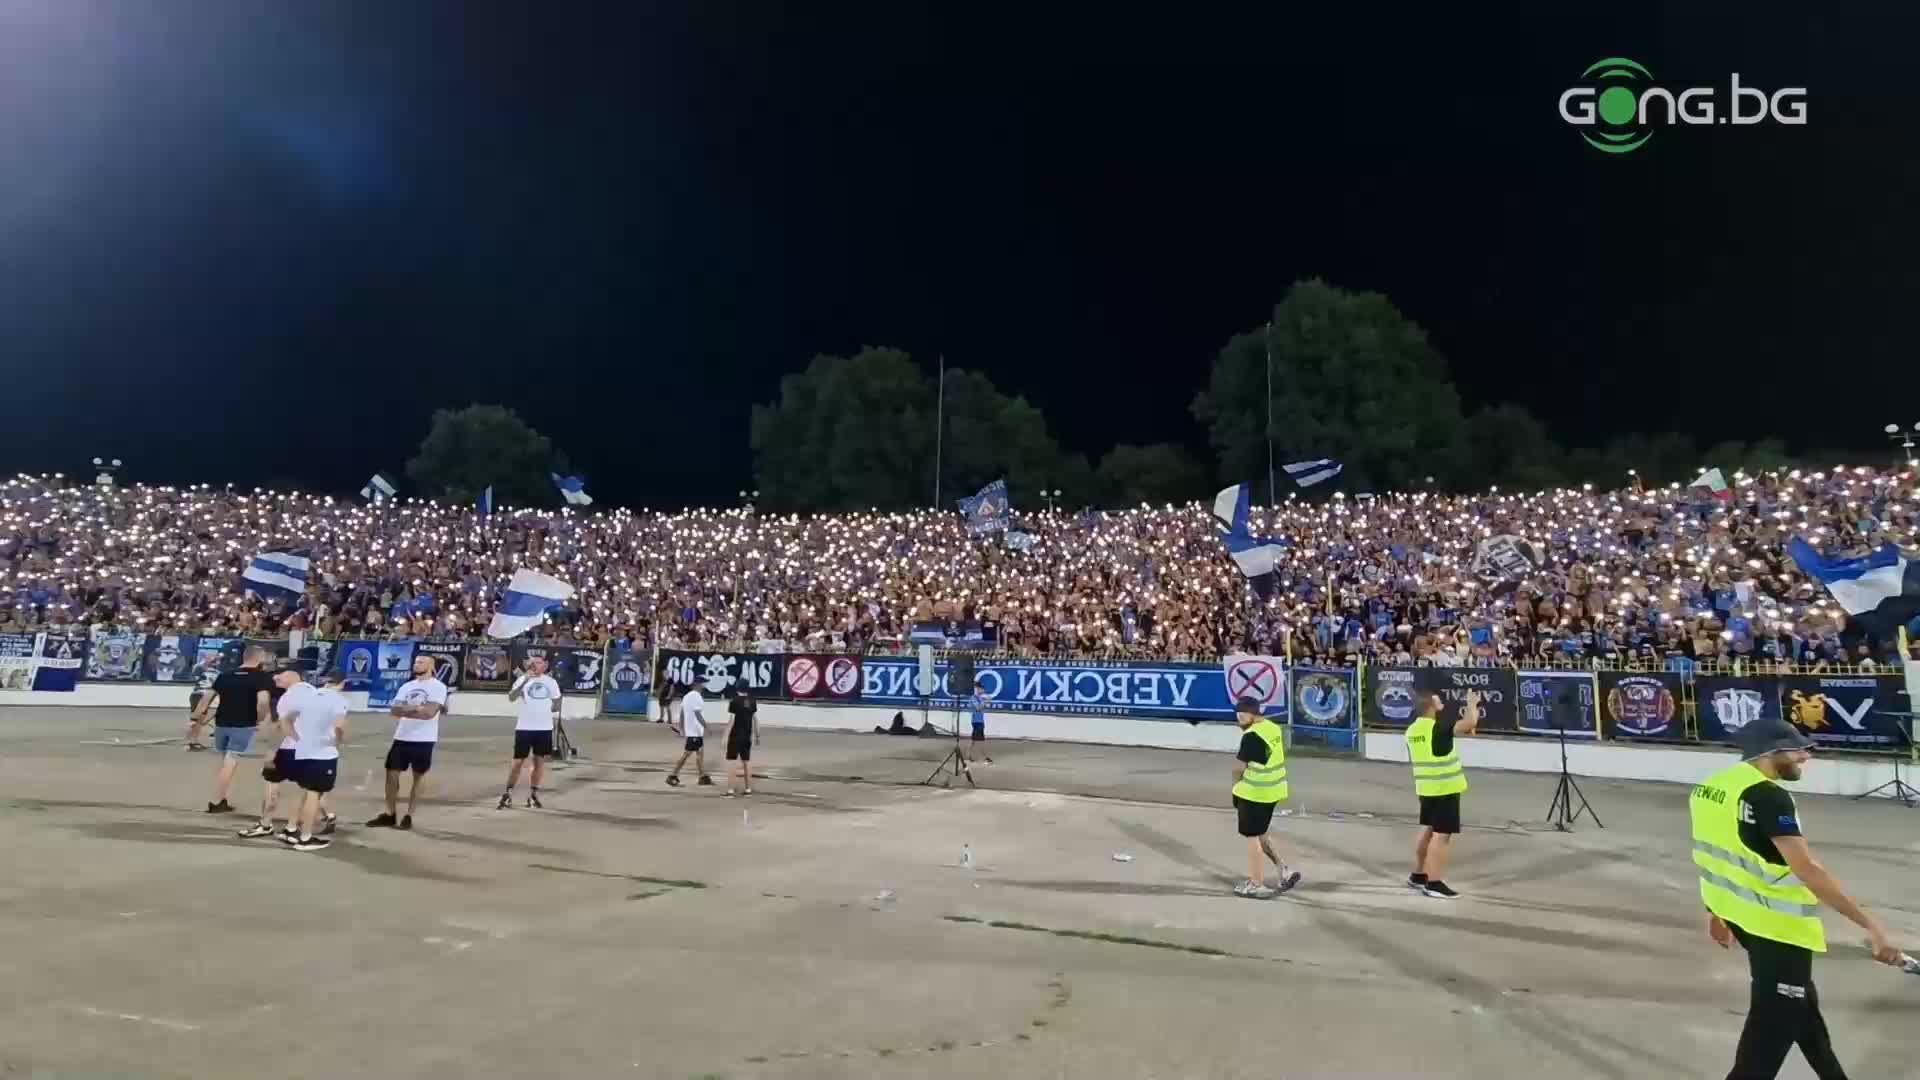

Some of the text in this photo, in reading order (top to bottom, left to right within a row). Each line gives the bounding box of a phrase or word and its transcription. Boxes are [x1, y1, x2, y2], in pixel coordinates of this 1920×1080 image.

[861, 665, 1196, 706] ЛЕВСКИ СФИЯ
[1451, 672, 1489, 686] BOYS
[1440, 688, 1503, 704] CATAL
